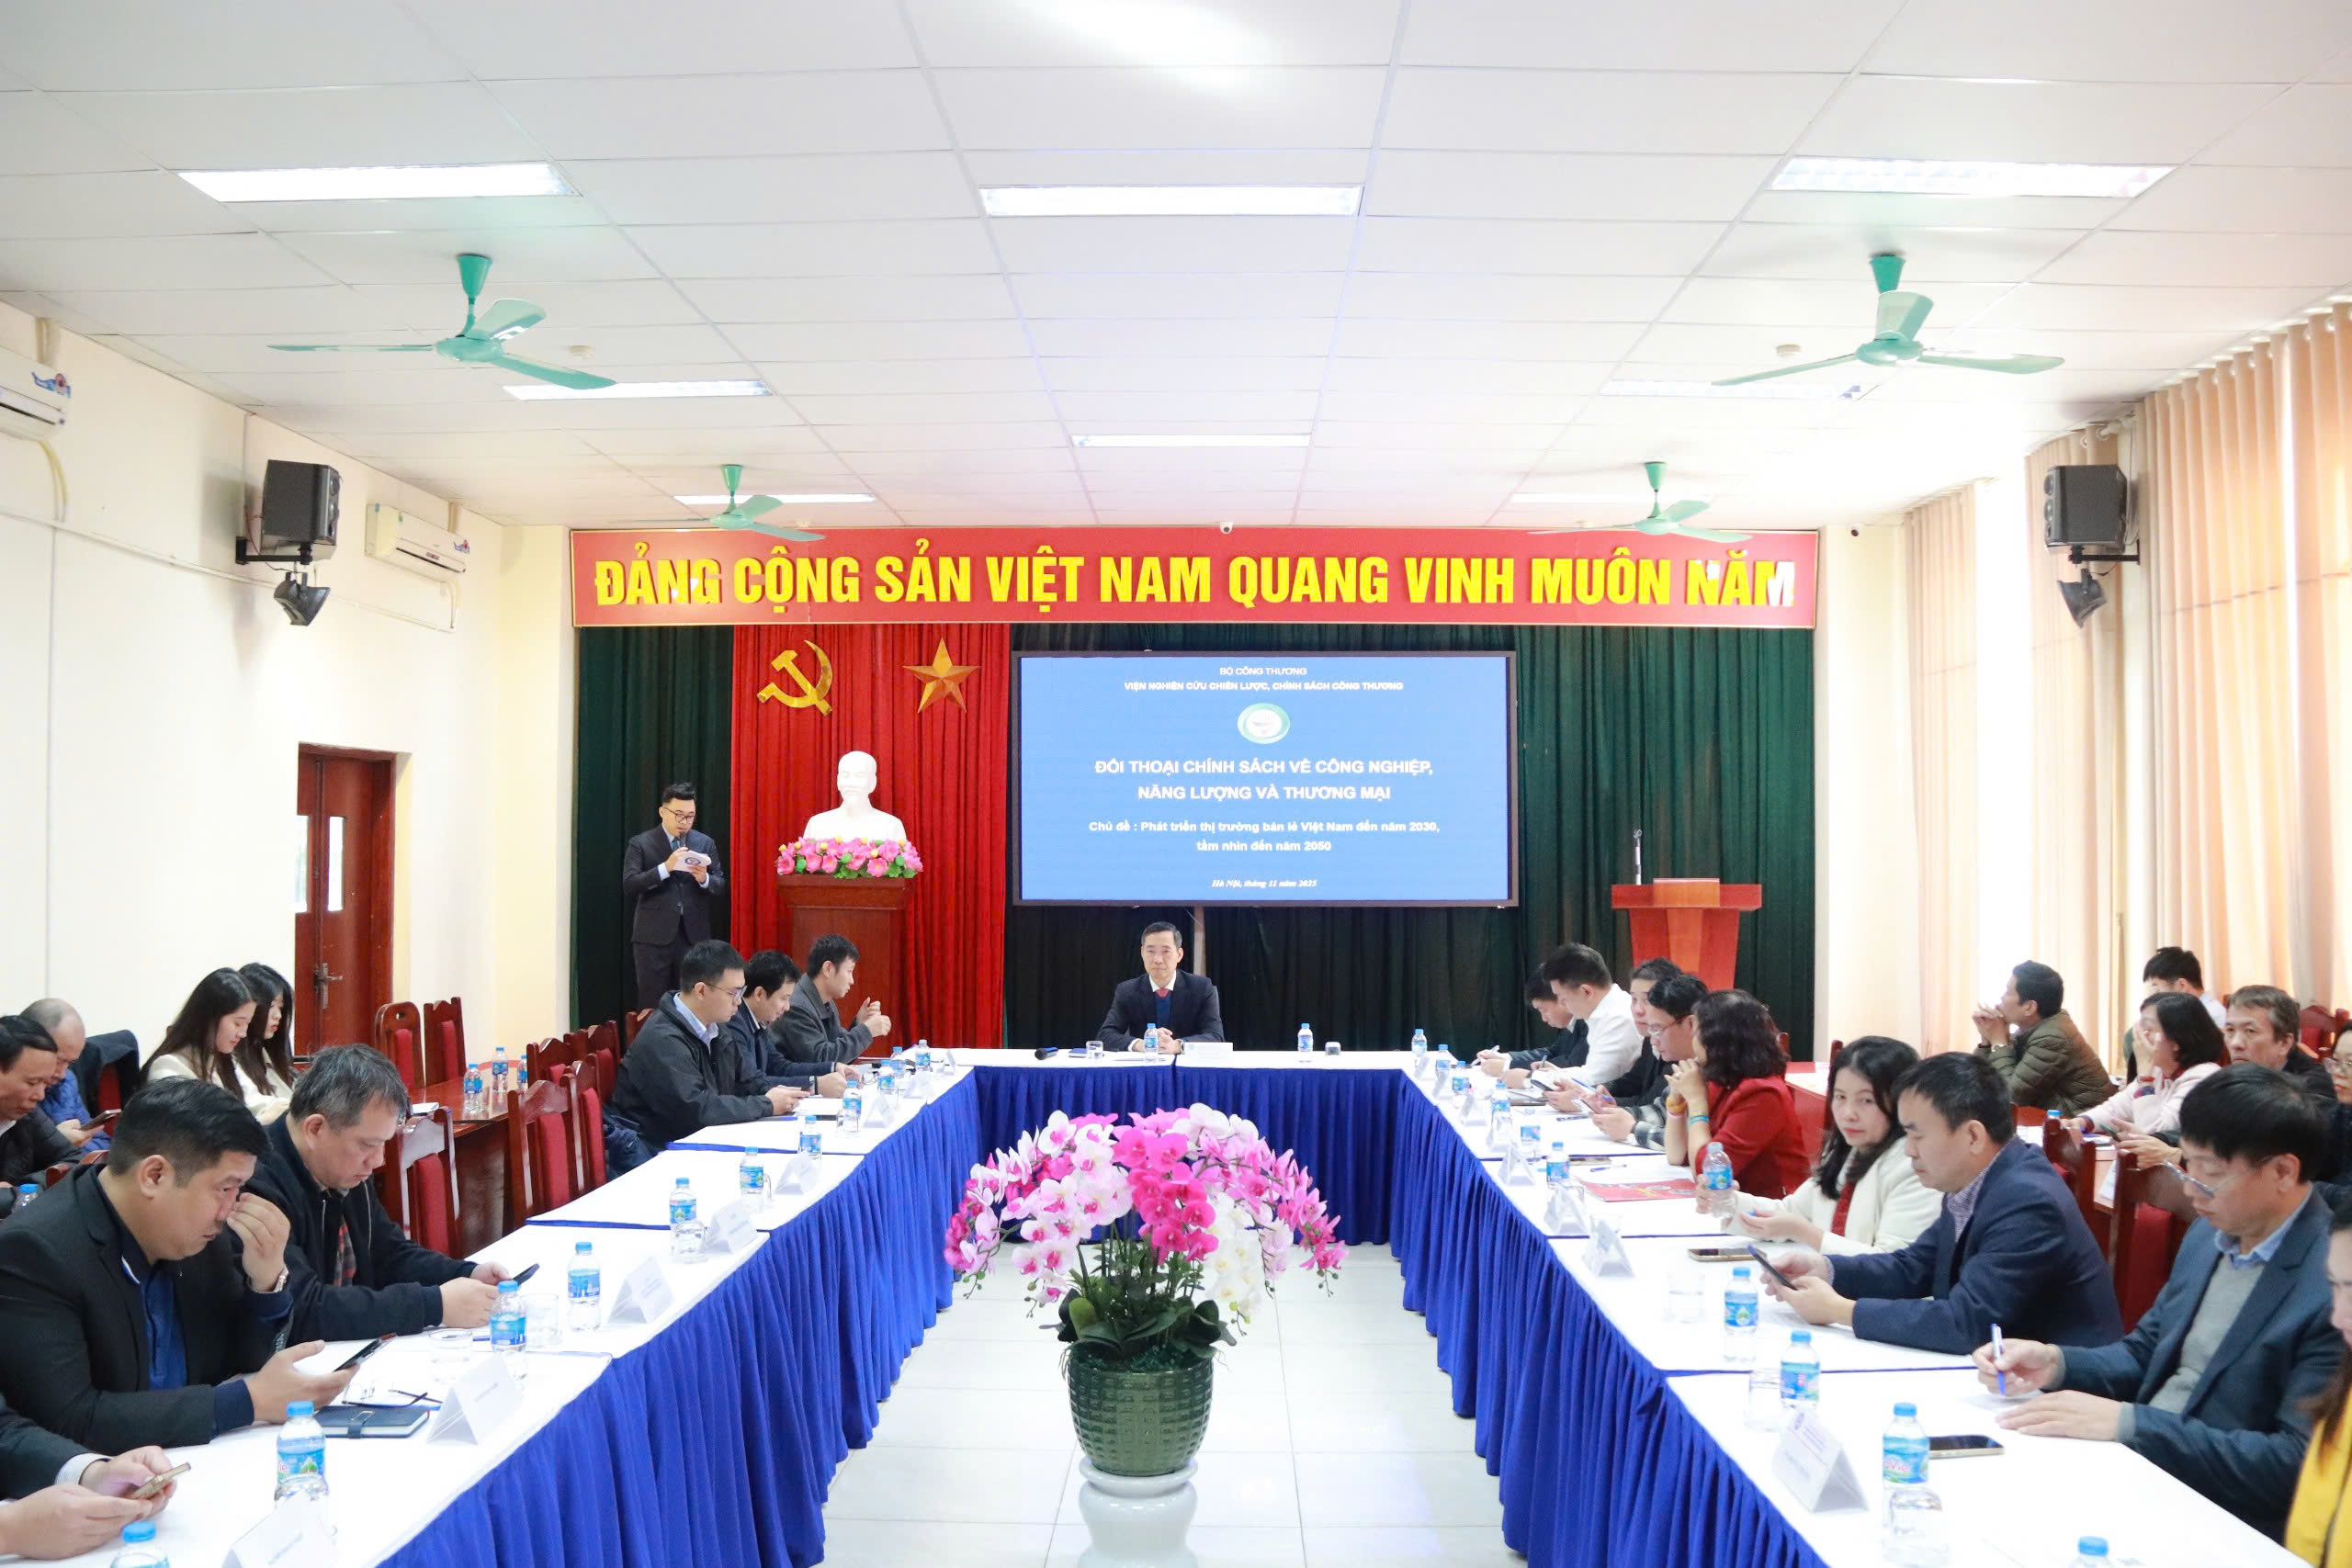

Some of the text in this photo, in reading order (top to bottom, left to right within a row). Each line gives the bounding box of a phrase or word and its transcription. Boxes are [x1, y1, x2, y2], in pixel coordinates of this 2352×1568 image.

[594, 538, 1795, 613] ĐẢNG CỘNG SẢN VIỆT NAM QUANG VINH MUÔN NĂM
[1219, 665, 1307, 676] BỘ CÔNG THƯƠNG
[1124, 680, 1404, 692] VIỆN NGHIÊN CỨU CHIẾN LƯỢC, CHÍNH SÁCH CÔNG THƯƠNG
[1128, 760, 1180, 776] THOẠI
[1182, 757, 1235, 773] CHÍNH
[1238, 757, 1285, 773] SÁCH
[1315, 758, 1364, 773] CÔNG
[1368, 758, 1434, 776] NGHIỆP,
[1137, 783, 1391, 802] NĂNG LƯỢNG VÀ THƯƠNG MẠI
[1088, 820, 1114, 831] Chủ
[1140, 821, 1168, 831] Phát
[1199, 822, 1216, 834] thị
[1217, 822, 1260, 834] trường
[1262, 821, 1284, 831] bán
[1300, 821, 1324, 833] Việt
[1326, 822, 1353, 831] Nam
[1355, 819, 1378, 831] đến
[1381, 822, 1407, 831] năm
[1408, 821, 1441, 833] 2030,
[1250, 839, 1273, 852] đến
[1275, 840, 1302, 852] năm
[1304, 840, 1332, 852] 2050
